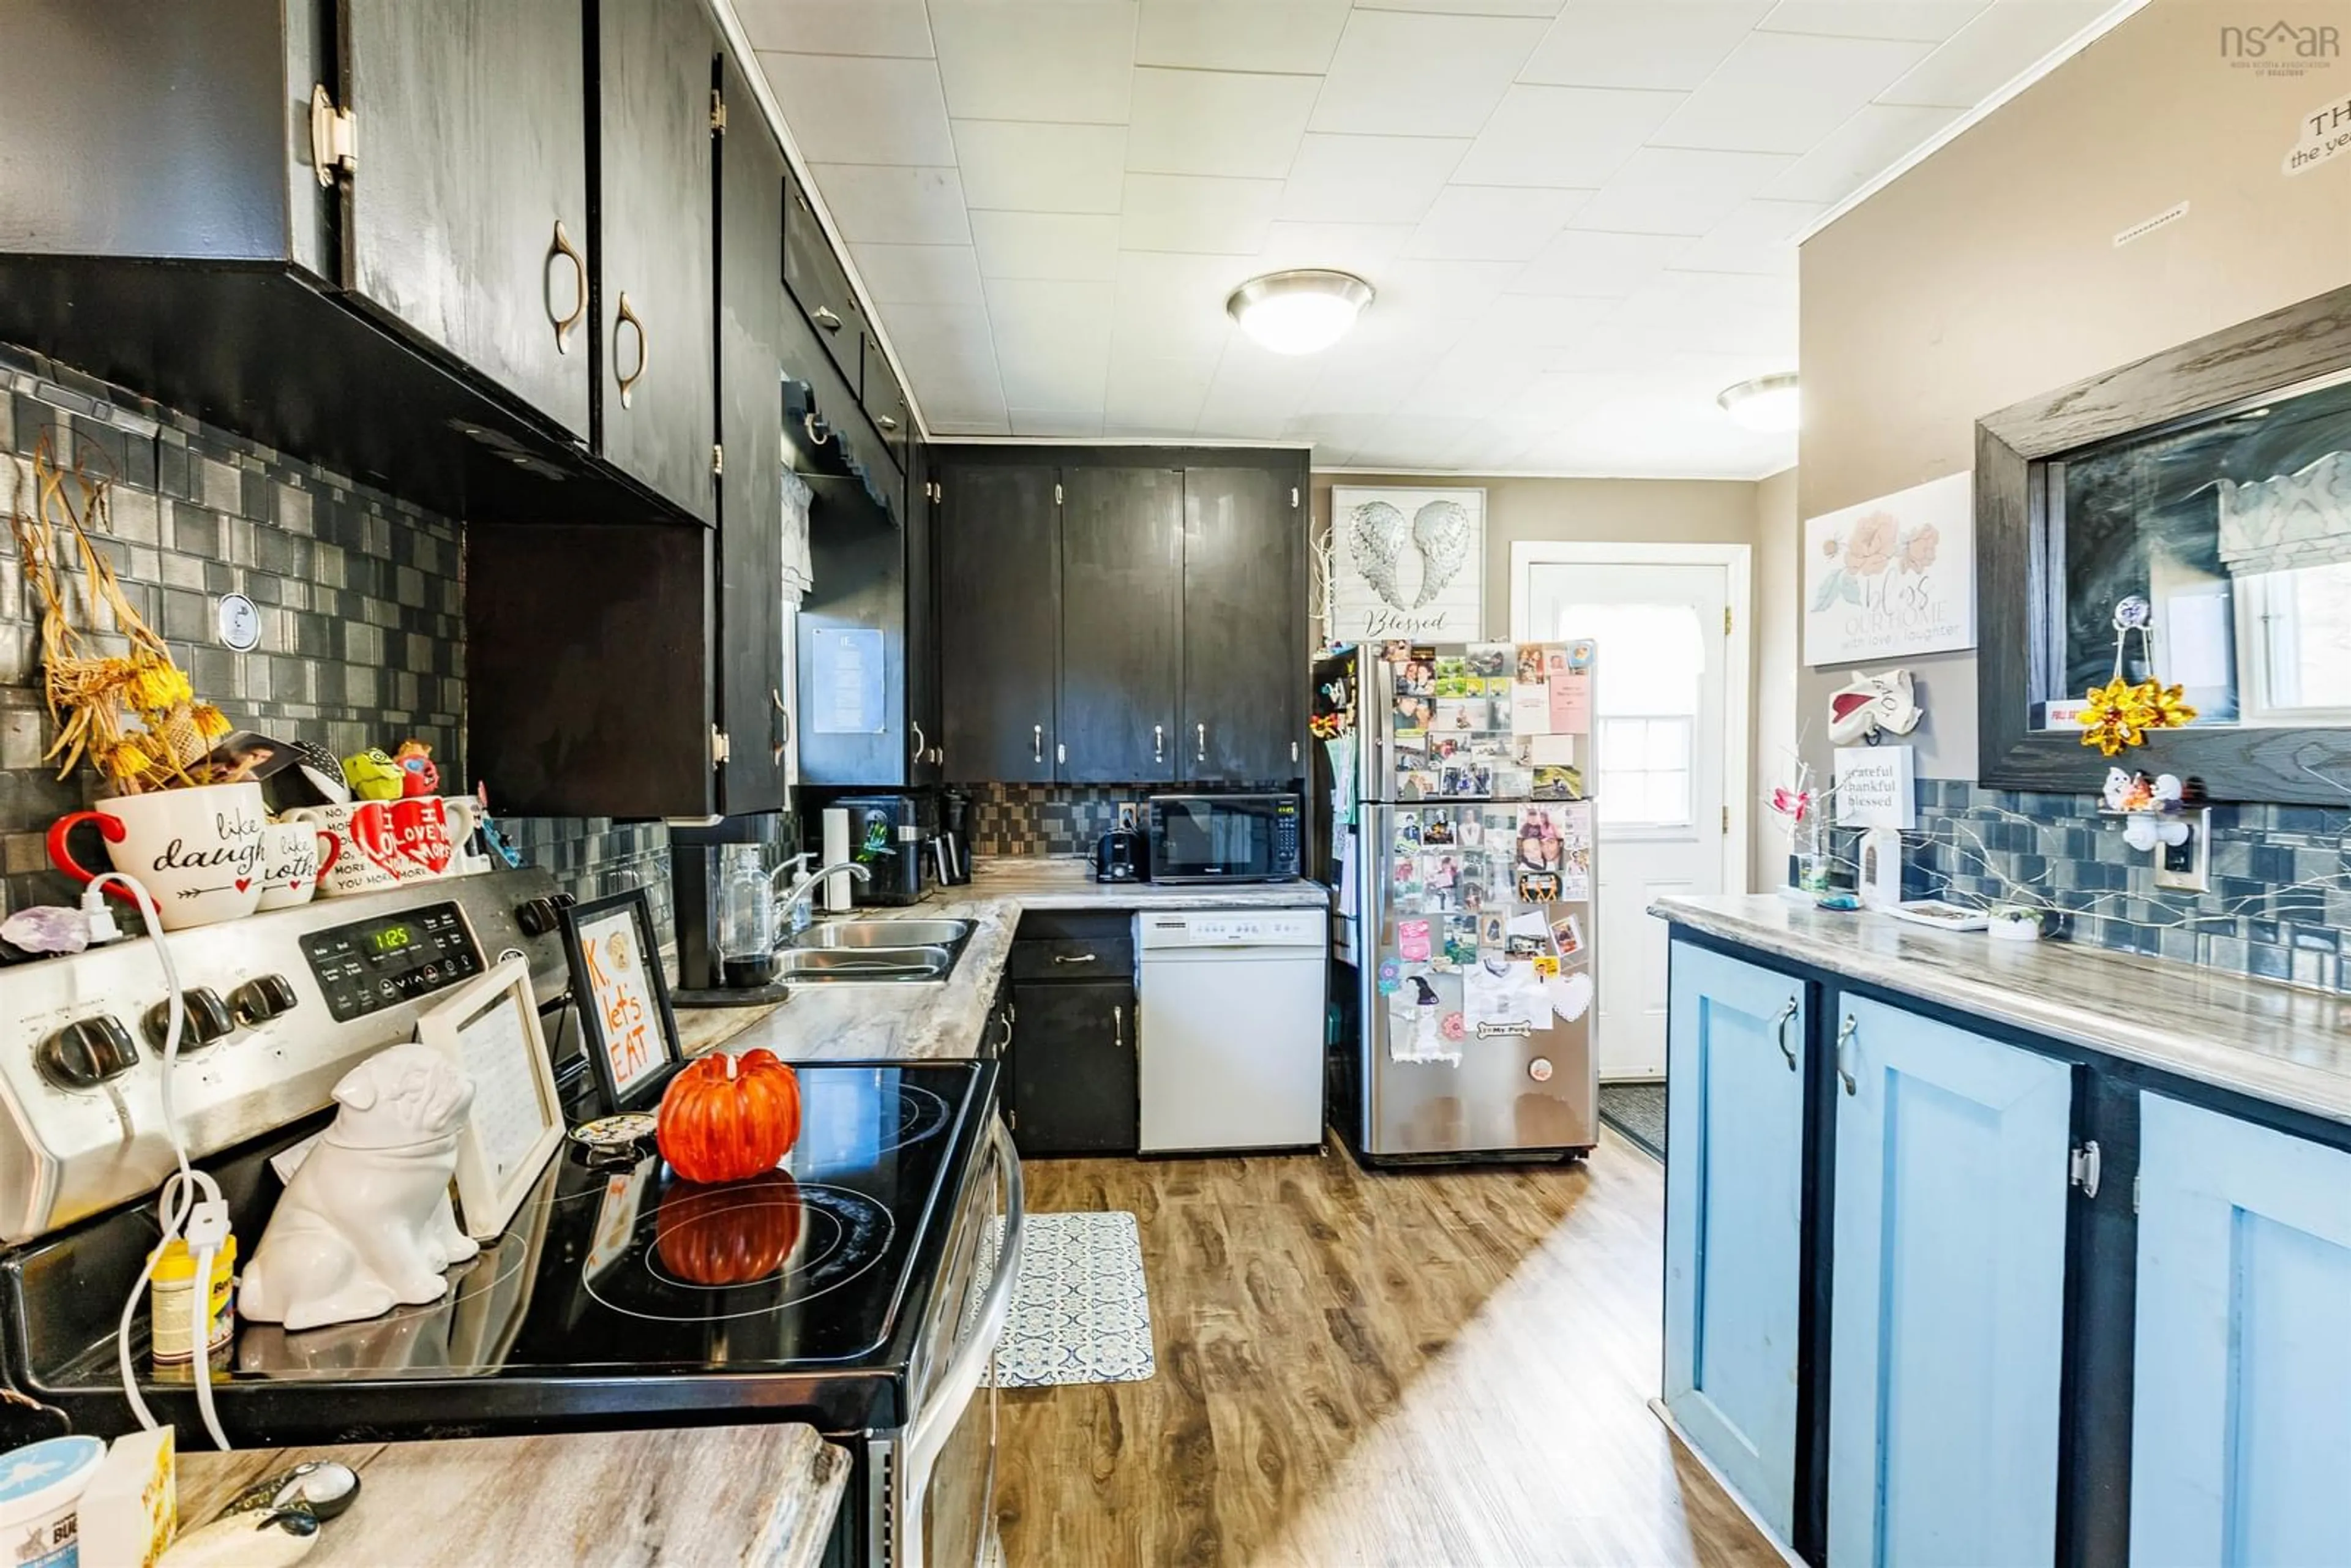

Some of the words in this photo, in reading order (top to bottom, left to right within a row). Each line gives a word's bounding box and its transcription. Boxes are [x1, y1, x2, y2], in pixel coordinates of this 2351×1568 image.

[2292, 147, 2320, 168] the
[2325, 132, 2351, 157] ye
[1363, 609, 1447, 637] Blessed
[1845, 765, 1893, 779] grateful
[1844, 779, 1895, 792] thankful
[1848, 795, 1892, 806] blessed
[216, 807, 259, 842] like
[392, 824, 437, 845] LOVE
[282, 831, 310, 855] like
[338, 878, 362, 889] YOU
[603, 982, 642, 1035] let's
[610, 1022, 648, 1083] EAT
